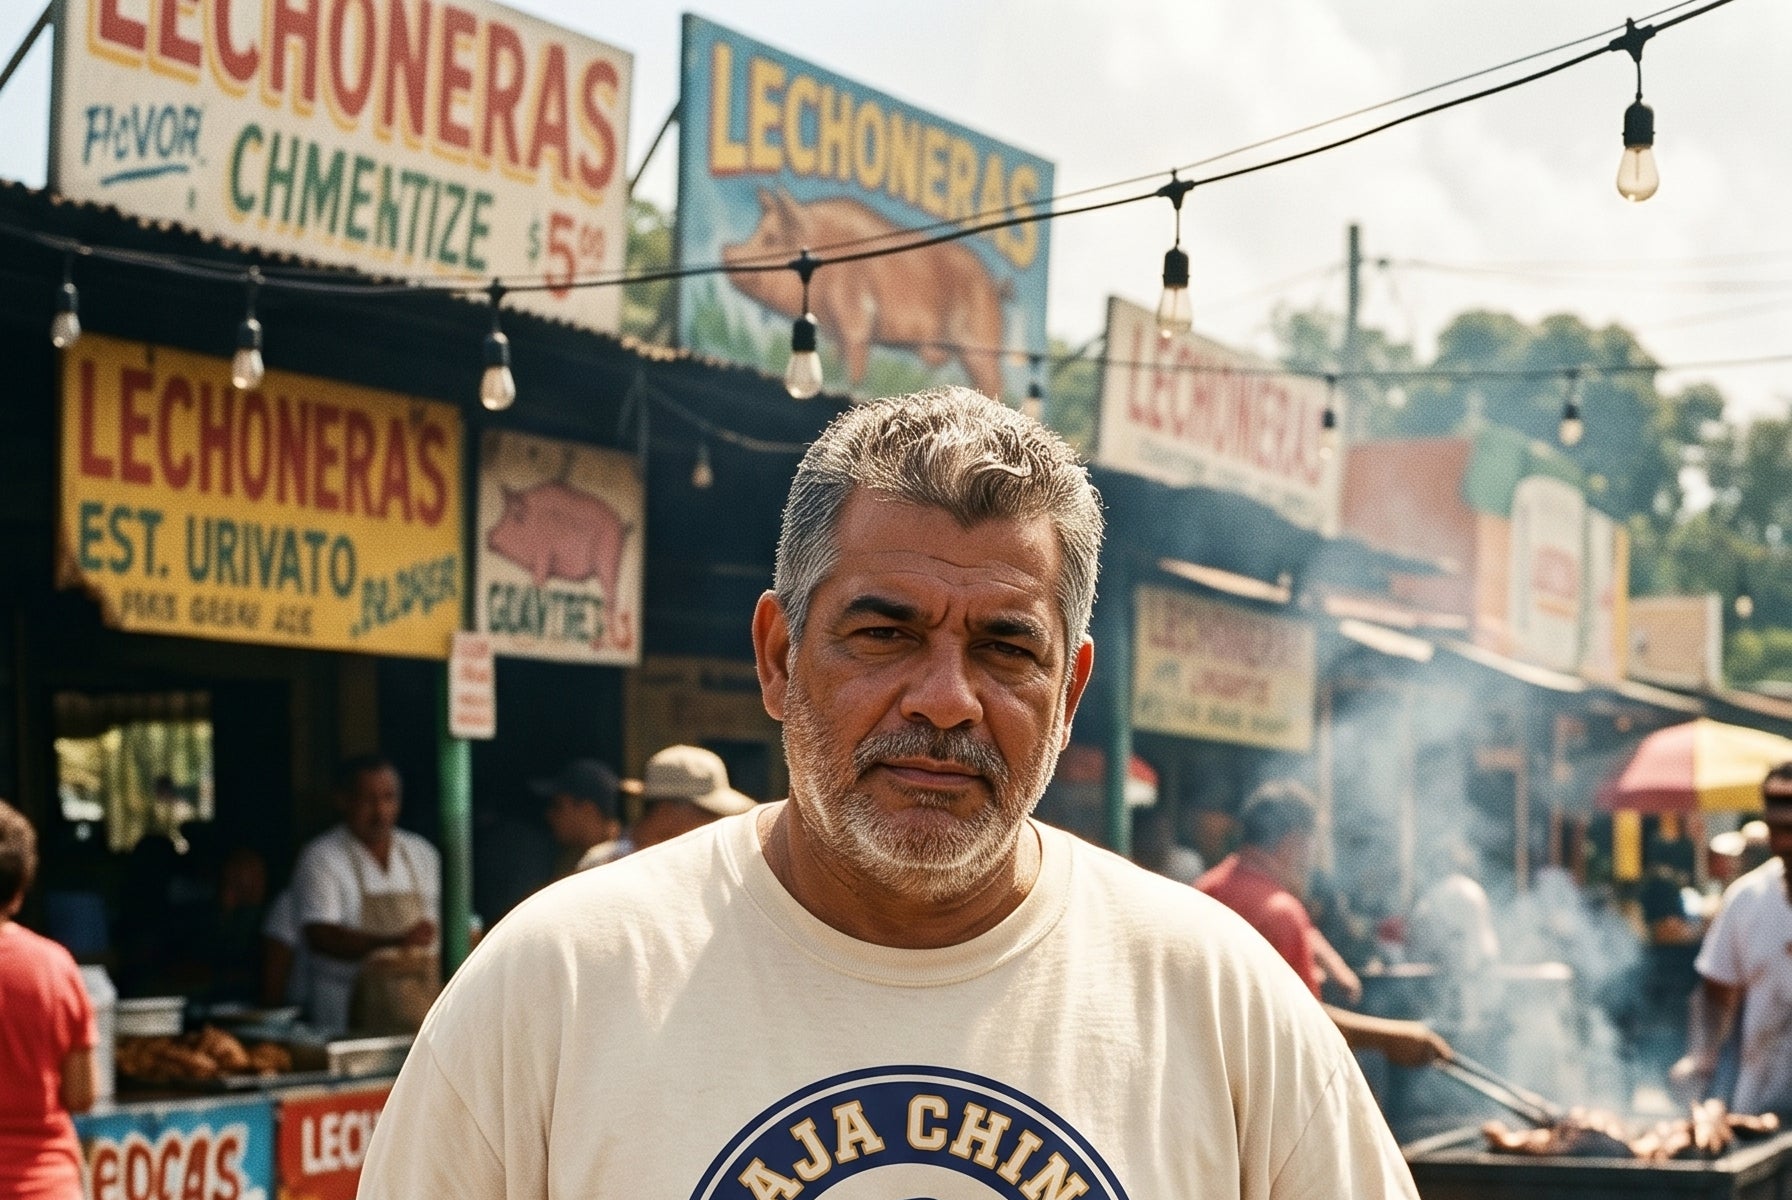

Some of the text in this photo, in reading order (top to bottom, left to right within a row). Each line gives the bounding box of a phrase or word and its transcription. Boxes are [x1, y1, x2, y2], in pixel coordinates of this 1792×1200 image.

[708, 42, 1040, 270] LECHONERAS
[78, 359, 449, 527] LECHONERAS
[78, 501, 170, 577] EST.
